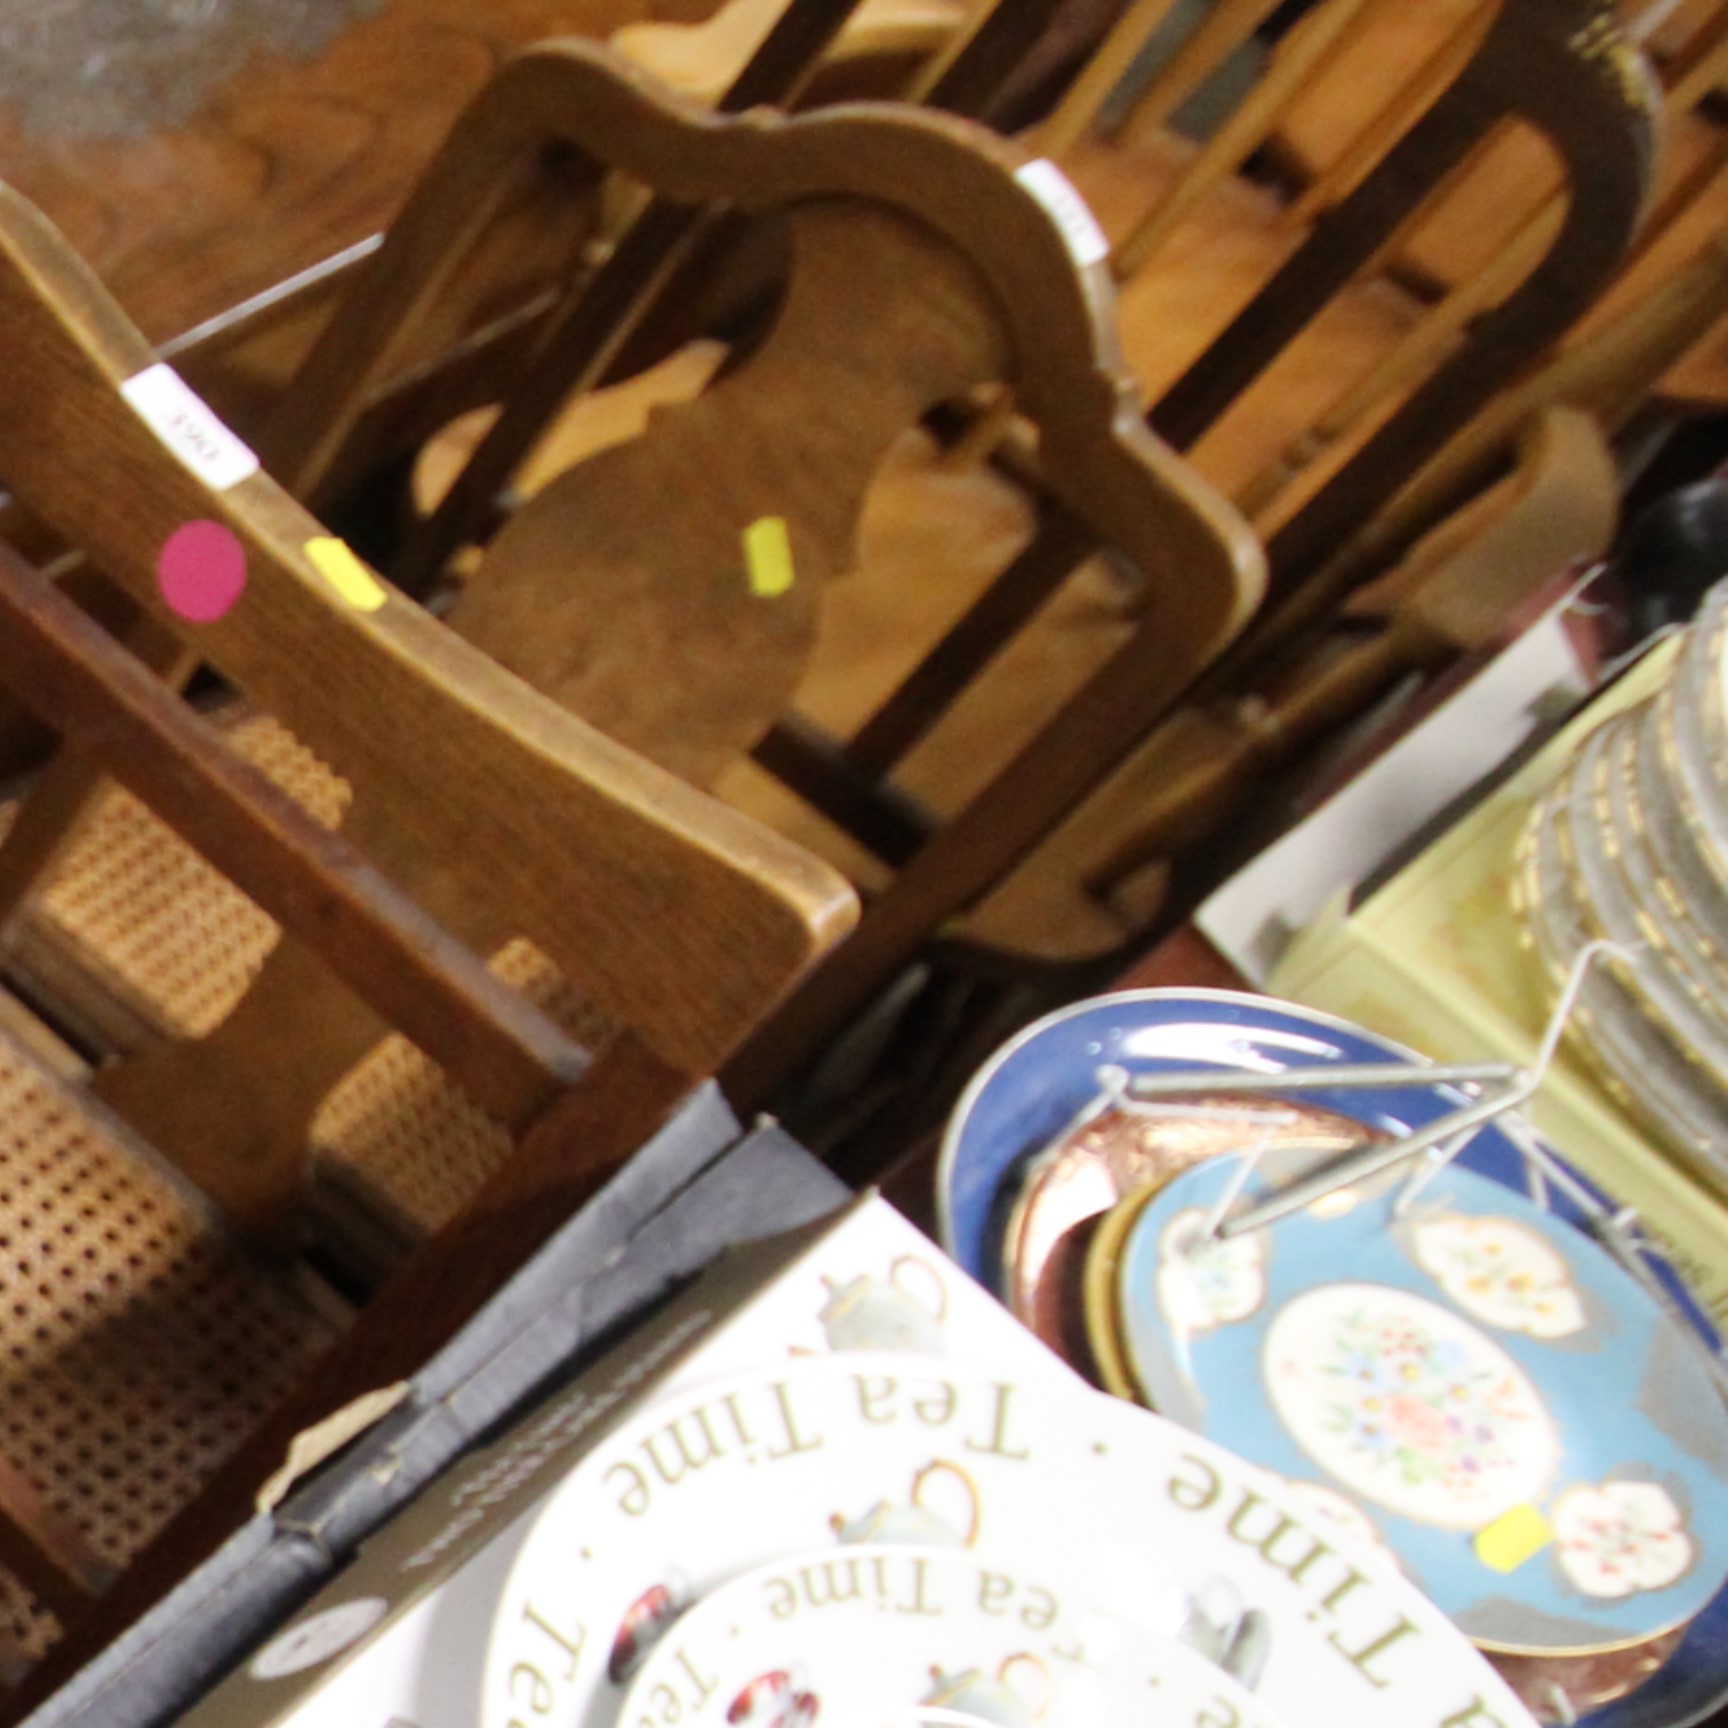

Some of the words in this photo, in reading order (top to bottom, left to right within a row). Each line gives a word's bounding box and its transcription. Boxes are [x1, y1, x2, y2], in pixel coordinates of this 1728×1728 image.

[601, 1379, 824, 1523] Time
[852, 1373, 1032, 1463] Tea
[764, 1555, 945, 1620] Time
[1165, 1453, 1423, 1691] Time
